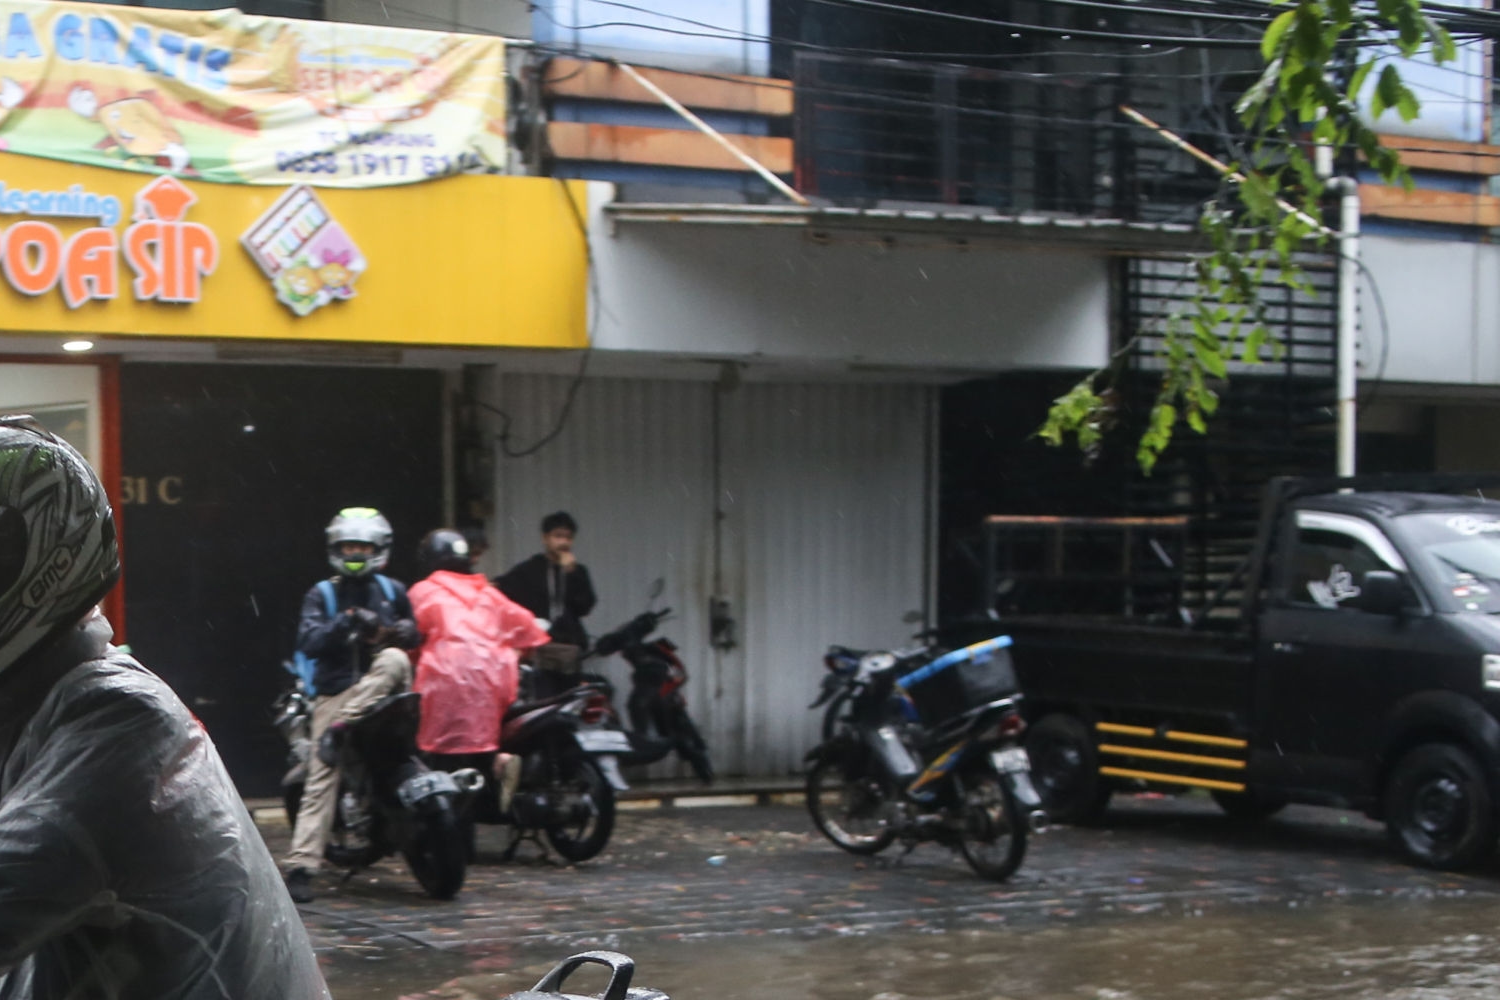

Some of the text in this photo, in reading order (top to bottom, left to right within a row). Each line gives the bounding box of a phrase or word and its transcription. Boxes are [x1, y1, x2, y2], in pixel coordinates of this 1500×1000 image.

[54, 13, 232, 91] GRATIS
[349, 153, 409, 176] 1917
[124, 218, 219, 302] SIP
[158, 476, 183, 504] C
[29, 547, 74, 606] BMC
